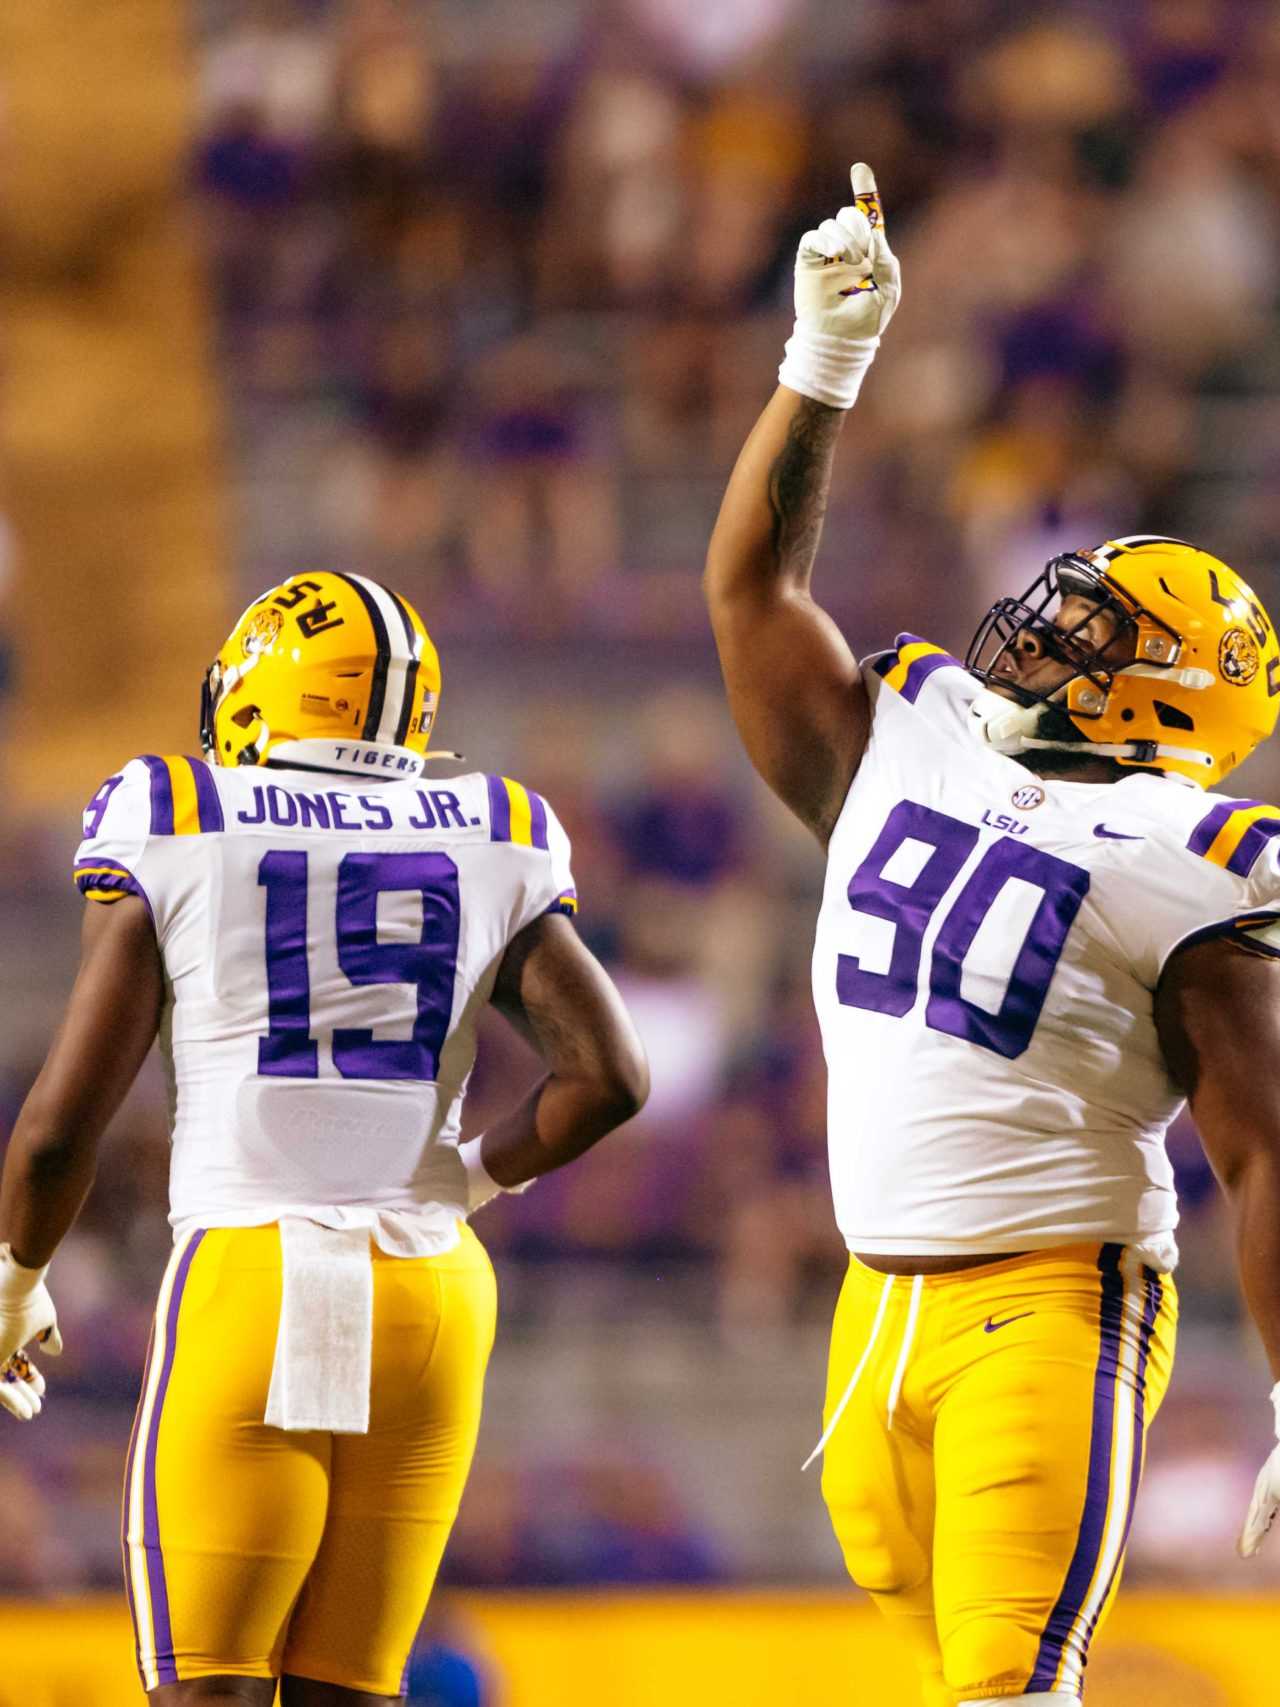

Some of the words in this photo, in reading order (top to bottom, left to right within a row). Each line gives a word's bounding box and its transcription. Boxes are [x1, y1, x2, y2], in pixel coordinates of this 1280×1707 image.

[335, 747, 419, 773] TIGERS
[238, 784, 393, 831] JONES
[409, 790, 481, 830] JR.
[981, 808, 1030, 835] LSU
[836, 798, 1090, 1060] 90
[257, 849, 461, 1081] 19
